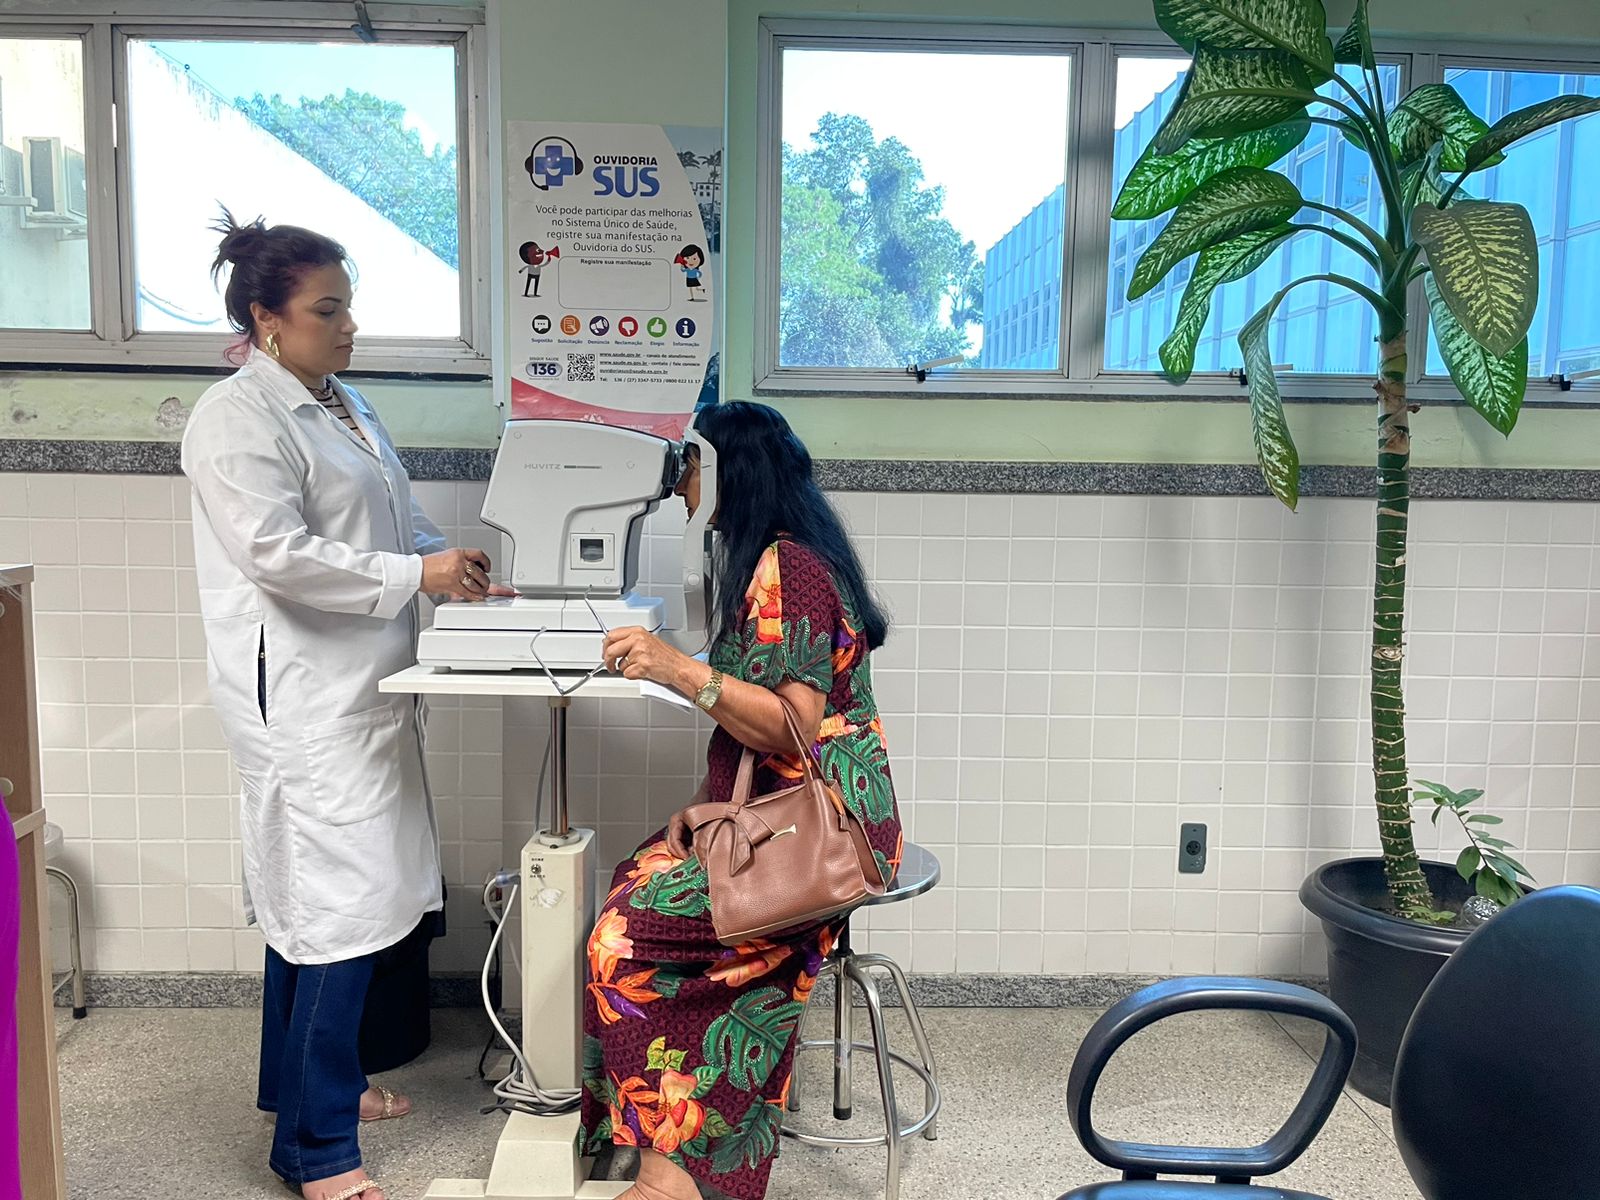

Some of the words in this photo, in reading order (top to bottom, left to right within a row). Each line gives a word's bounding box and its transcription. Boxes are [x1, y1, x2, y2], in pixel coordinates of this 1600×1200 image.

[594, 156, 657, 166] OUVIDORIA
[593, 166, 660, 198] SUS
[536, 205, 557, 214] Você
[560, 207, 582, 216] pode
[586, 207, 627, 217] participar
[630, 208, 646, 217] das
[649, 209, 692, 218] melhorias
[566, 218, 600, 227] Sistema
[604, 217, 629, 228] Único
[632, 220, 643, 229] de
[646, 220, 677, 231] Saúde,
[547, 231, 582, 240] registre
[605, 232, 668, 242] manifestação
[573, 242, 618, 252] Ouvidoria
[621, 243, 632, 252] do
[636, 244, 655, 253] SUS.
[532, 363, 556, 375] 136
